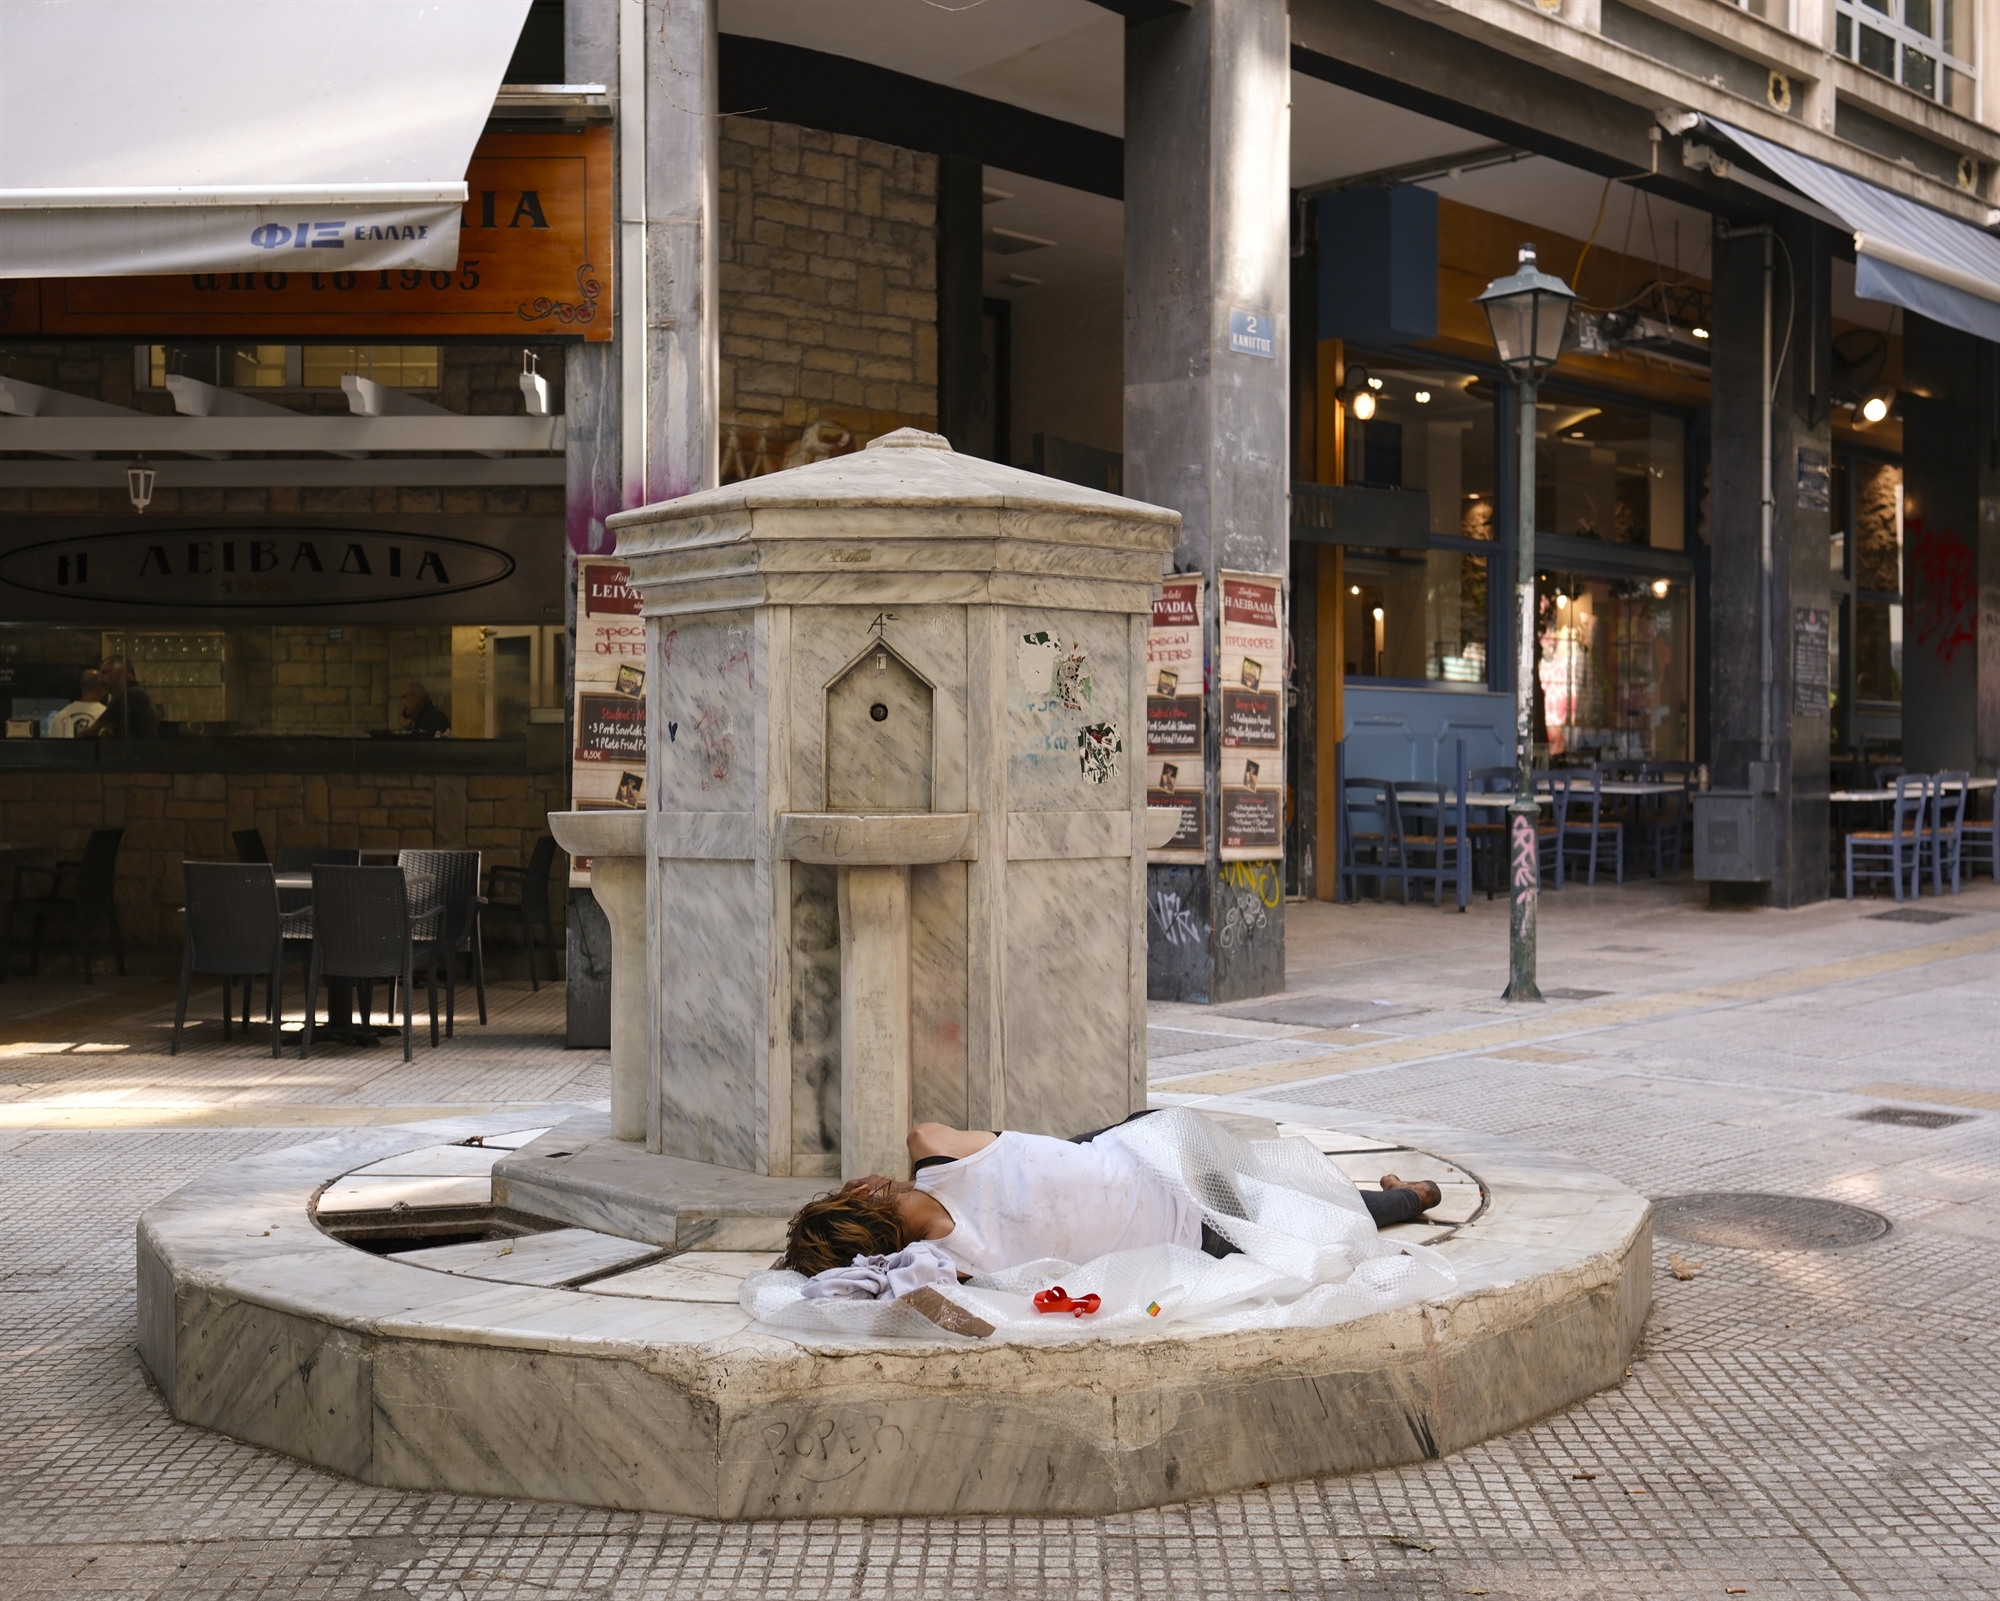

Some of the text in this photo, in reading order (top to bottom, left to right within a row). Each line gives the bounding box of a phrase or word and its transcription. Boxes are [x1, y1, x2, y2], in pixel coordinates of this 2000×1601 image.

[460, 190, 550, 228] ΙΑ
[250, 221, 429, 249] ΦΙΞ ΕΛΛΑΣ
[376, 259, 480, 291] 1965
[1246, 315, 1257, 334] 2
[57, 540, 450, 586] Η ΛΕΙΒΑΔΙΑ
[220, 577, 290, 595] 1965
[592, 583, 644, 600] LEIVA
[1151, 601, 1194, 614] IVADIA
[1233, 598, 1274, 614] ΛΕΙΒΑΔΙΑ
[1147, 632, 1189, 650] pecial
[1225, 635, 1275, 650] ΠΡΟΣΦΟΡΕΣ
[599, 722, 615, 735] Pork
[620, 738, 639, 752] Fried
